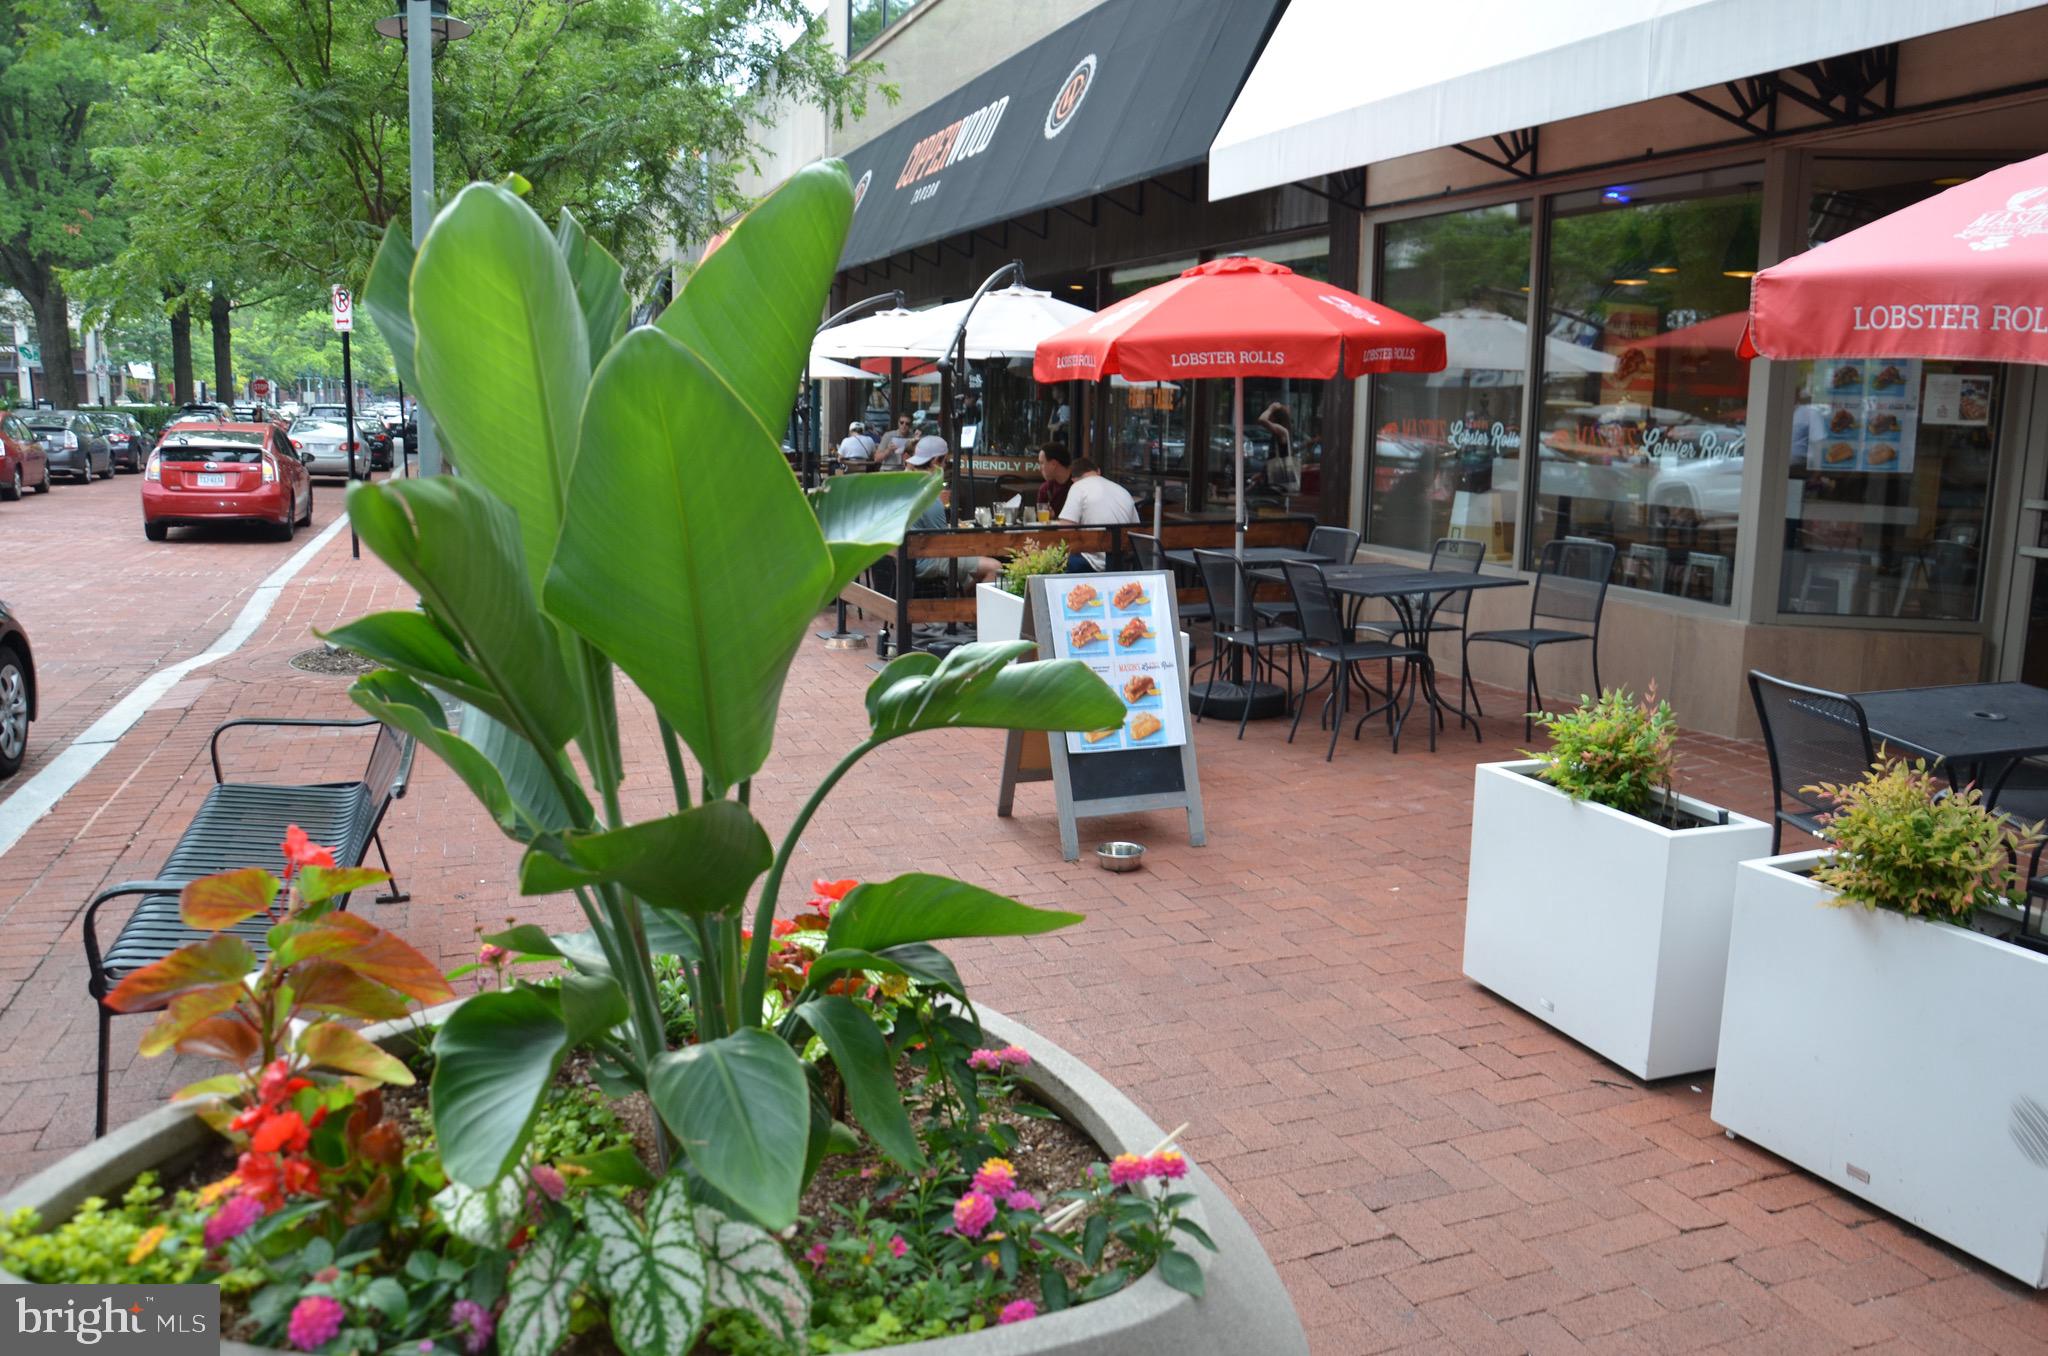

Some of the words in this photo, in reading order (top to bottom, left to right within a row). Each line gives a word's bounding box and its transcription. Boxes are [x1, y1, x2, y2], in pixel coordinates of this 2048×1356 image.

[895, 95, 1010, 191] COPPERWOOD
[1853, 303, 1980, 331] LOBSTER
[1990, 304, 2048, 333] ROL
[1171, 351, 1236, 367] LOBSTER
[1239, 351, 1284, 365] ROLLS
[1448, 420, 1489, 449] Lobster
[1641, 428, 1696, 459] Lobster
